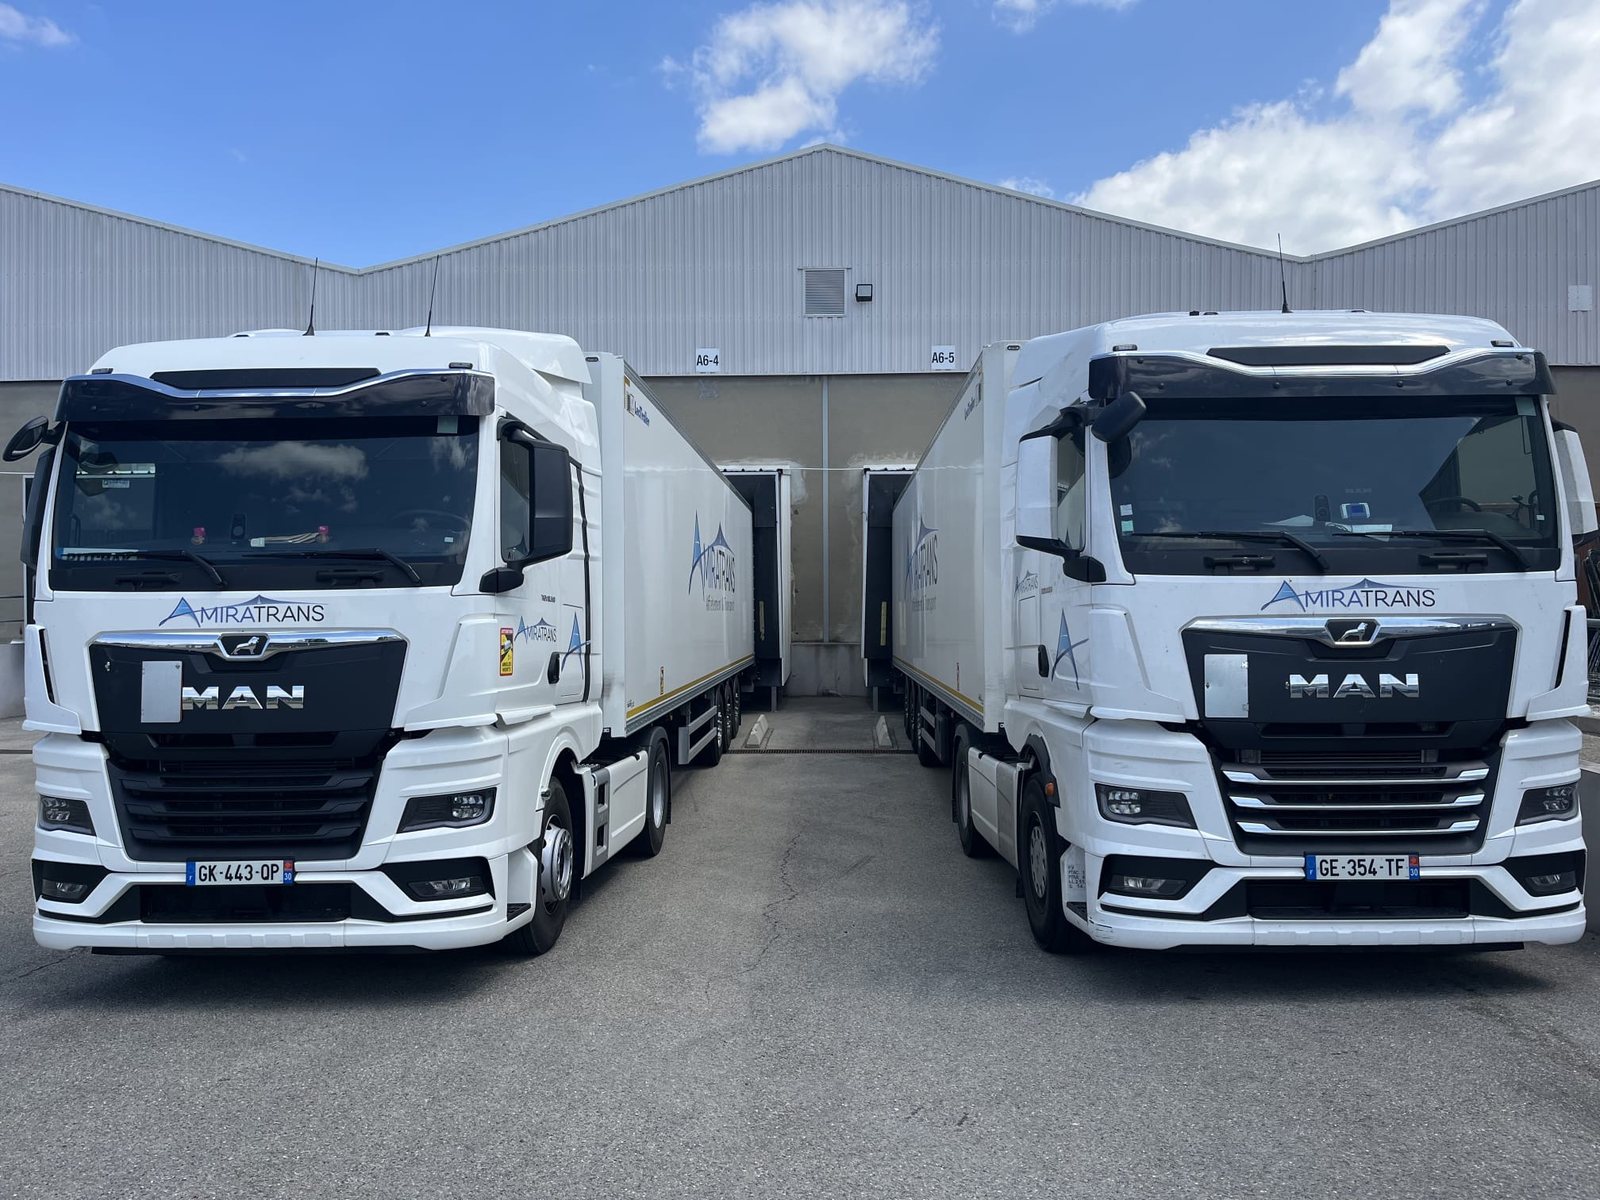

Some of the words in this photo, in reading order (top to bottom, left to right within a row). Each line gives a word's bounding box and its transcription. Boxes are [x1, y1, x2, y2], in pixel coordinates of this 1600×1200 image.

[697, 355, 719, 366] A6-4
[932, 352, 955, 363] A6-5
[1289, 673, 1420, 698] MAN
[181, 685, 305, 711] MAN
[198, 863, 280, 882] GK-443-QP
[1319, 858, 1405, 877] GE-354-TF
[1410, 868, 1419, 876] 30
[284, 872, 292, 881] 30
